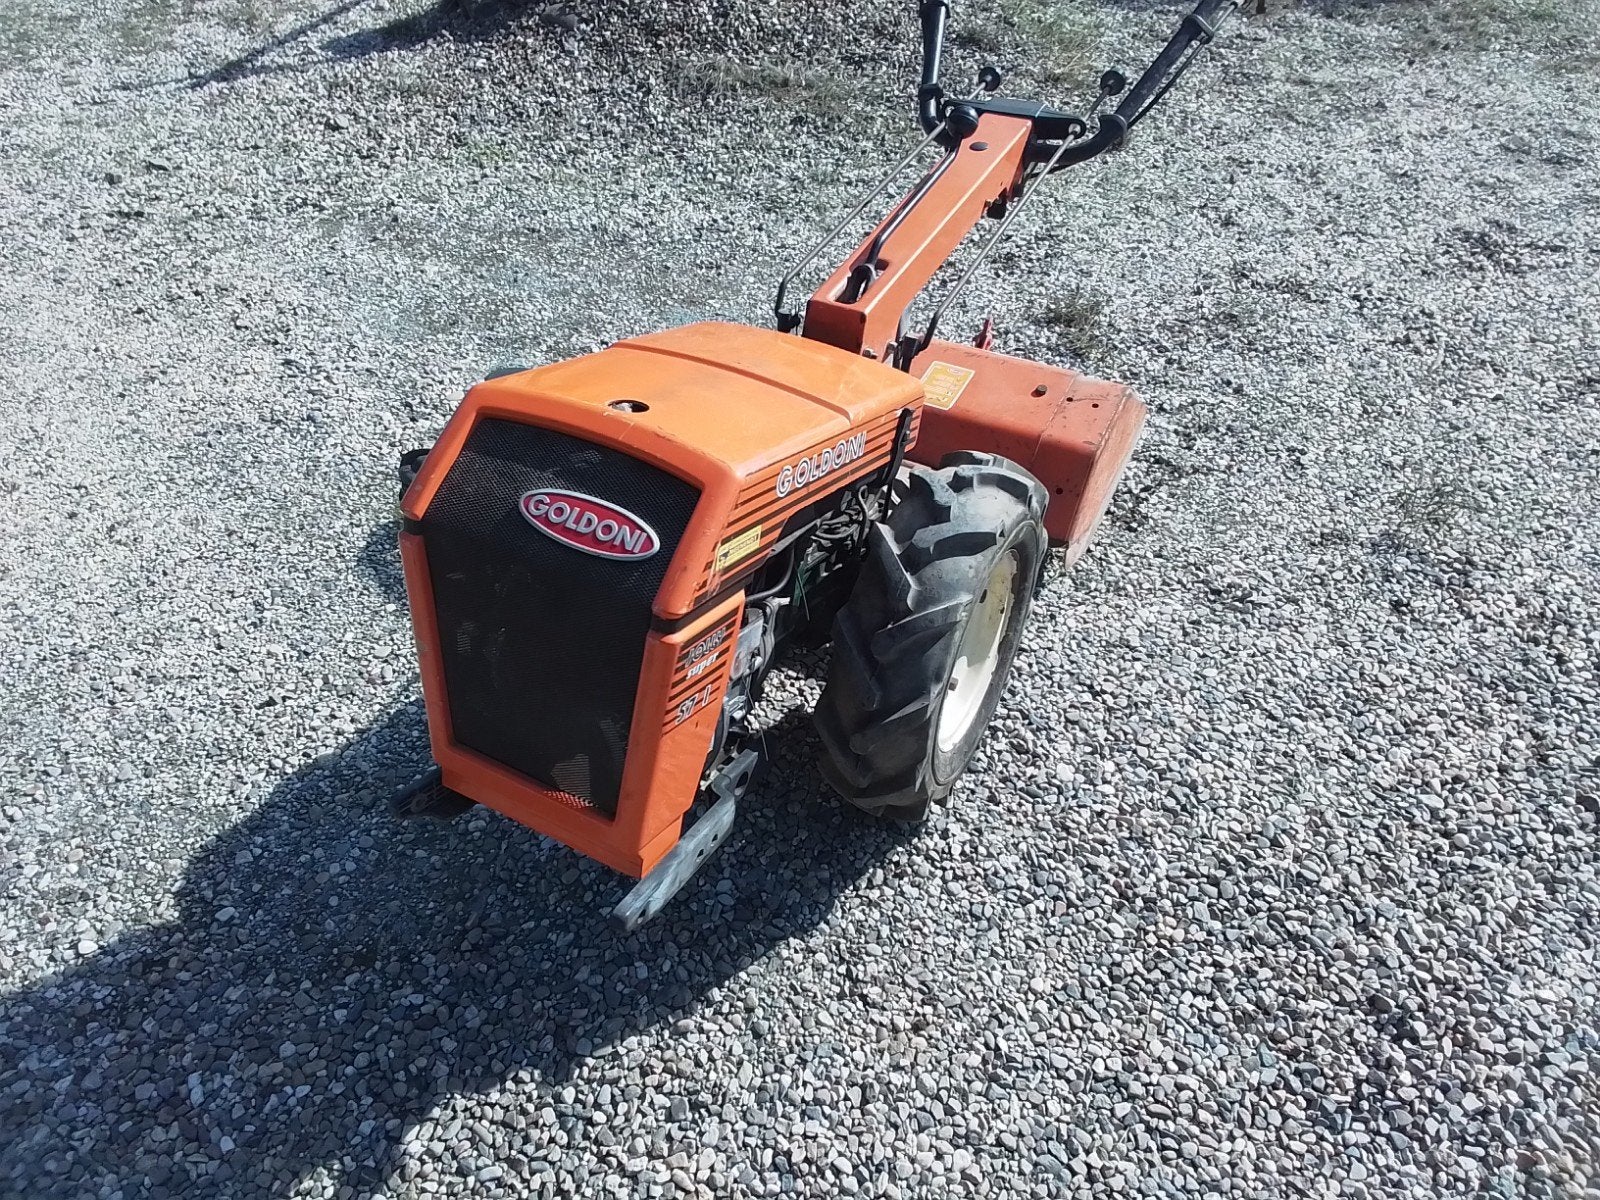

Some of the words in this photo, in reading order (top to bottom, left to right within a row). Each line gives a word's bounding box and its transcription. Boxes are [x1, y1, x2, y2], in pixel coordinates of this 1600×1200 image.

[776, 431, 867, 498] GOLDONI
[527, 494, 648, 554] GOLDONI
[685, 651, 720, 680] super
